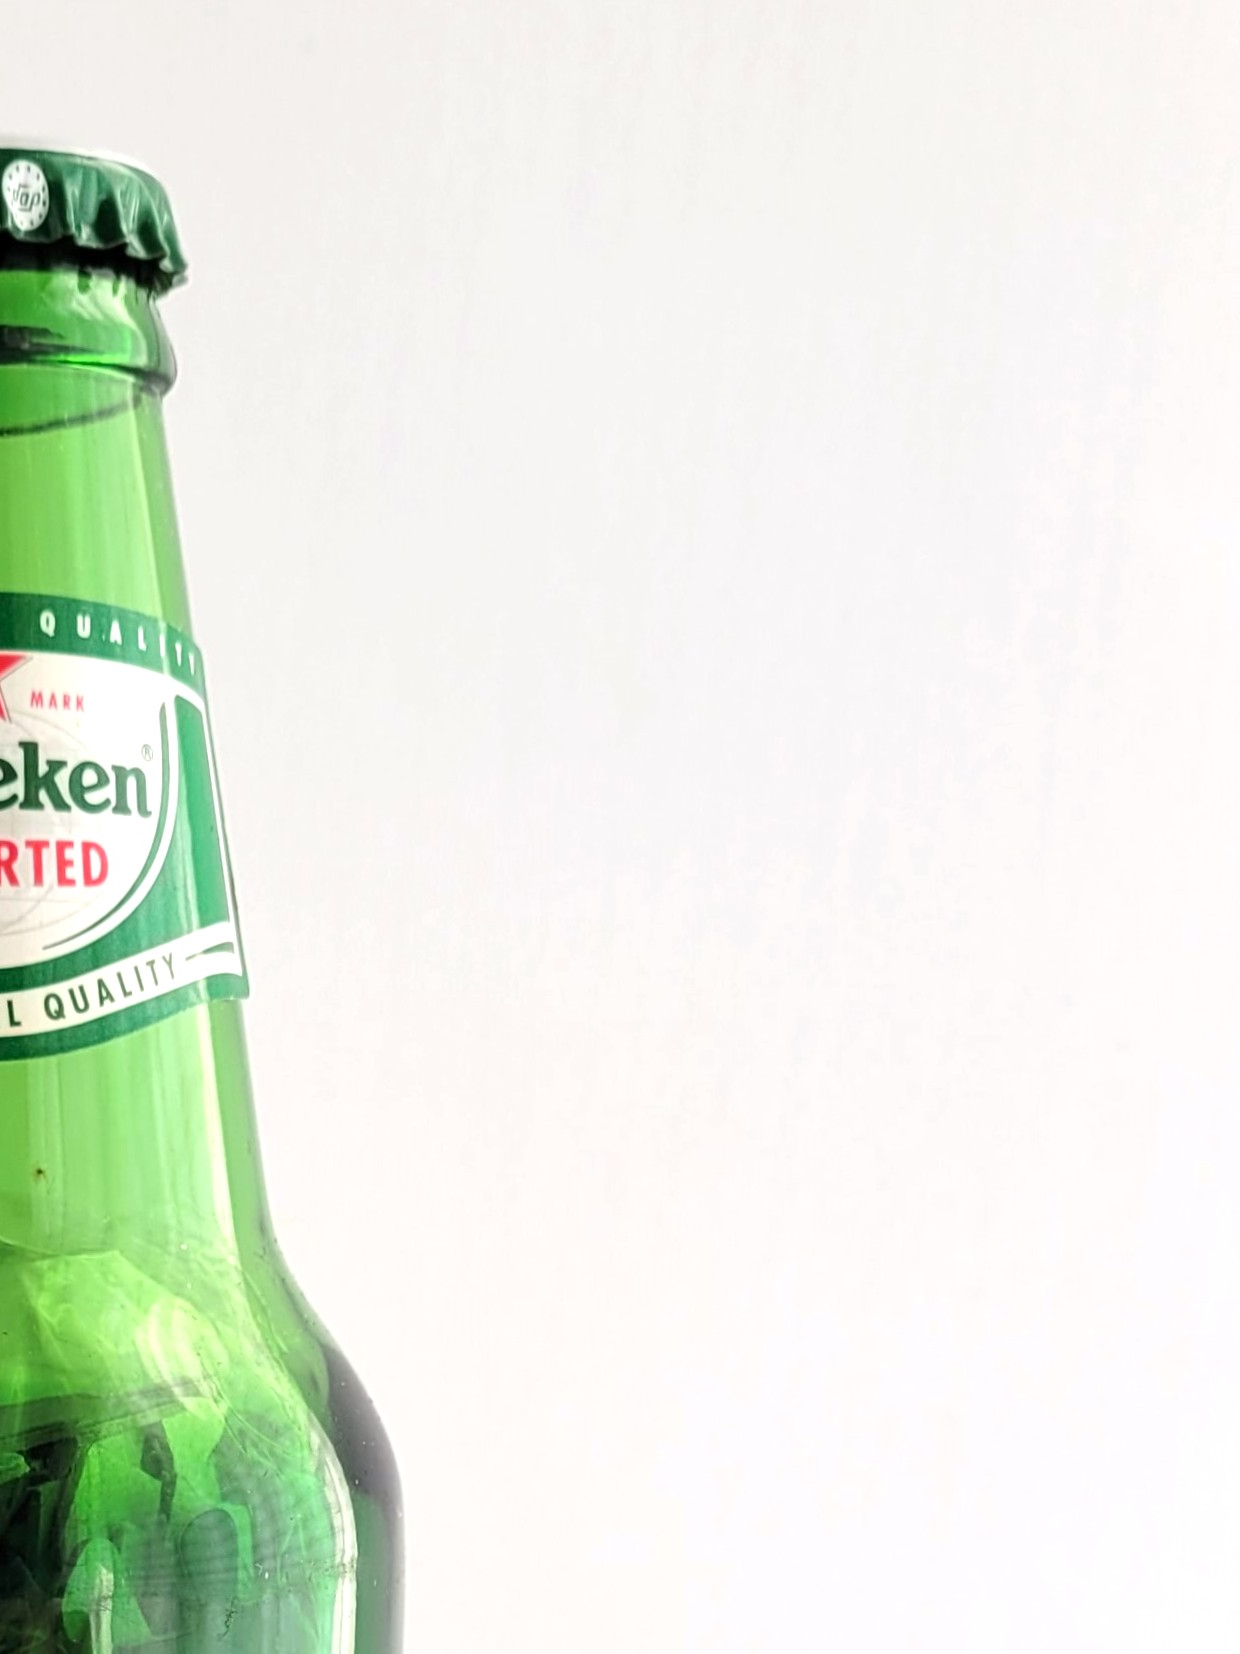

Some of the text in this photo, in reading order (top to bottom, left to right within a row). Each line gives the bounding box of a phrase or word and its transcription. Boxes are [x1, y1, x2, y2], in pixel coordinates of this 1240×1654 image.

[39, 609, 196, 677] QUALITY
[30, 689, 85, 712] MARK
[44, 952, 178, 1021] QUALITY
